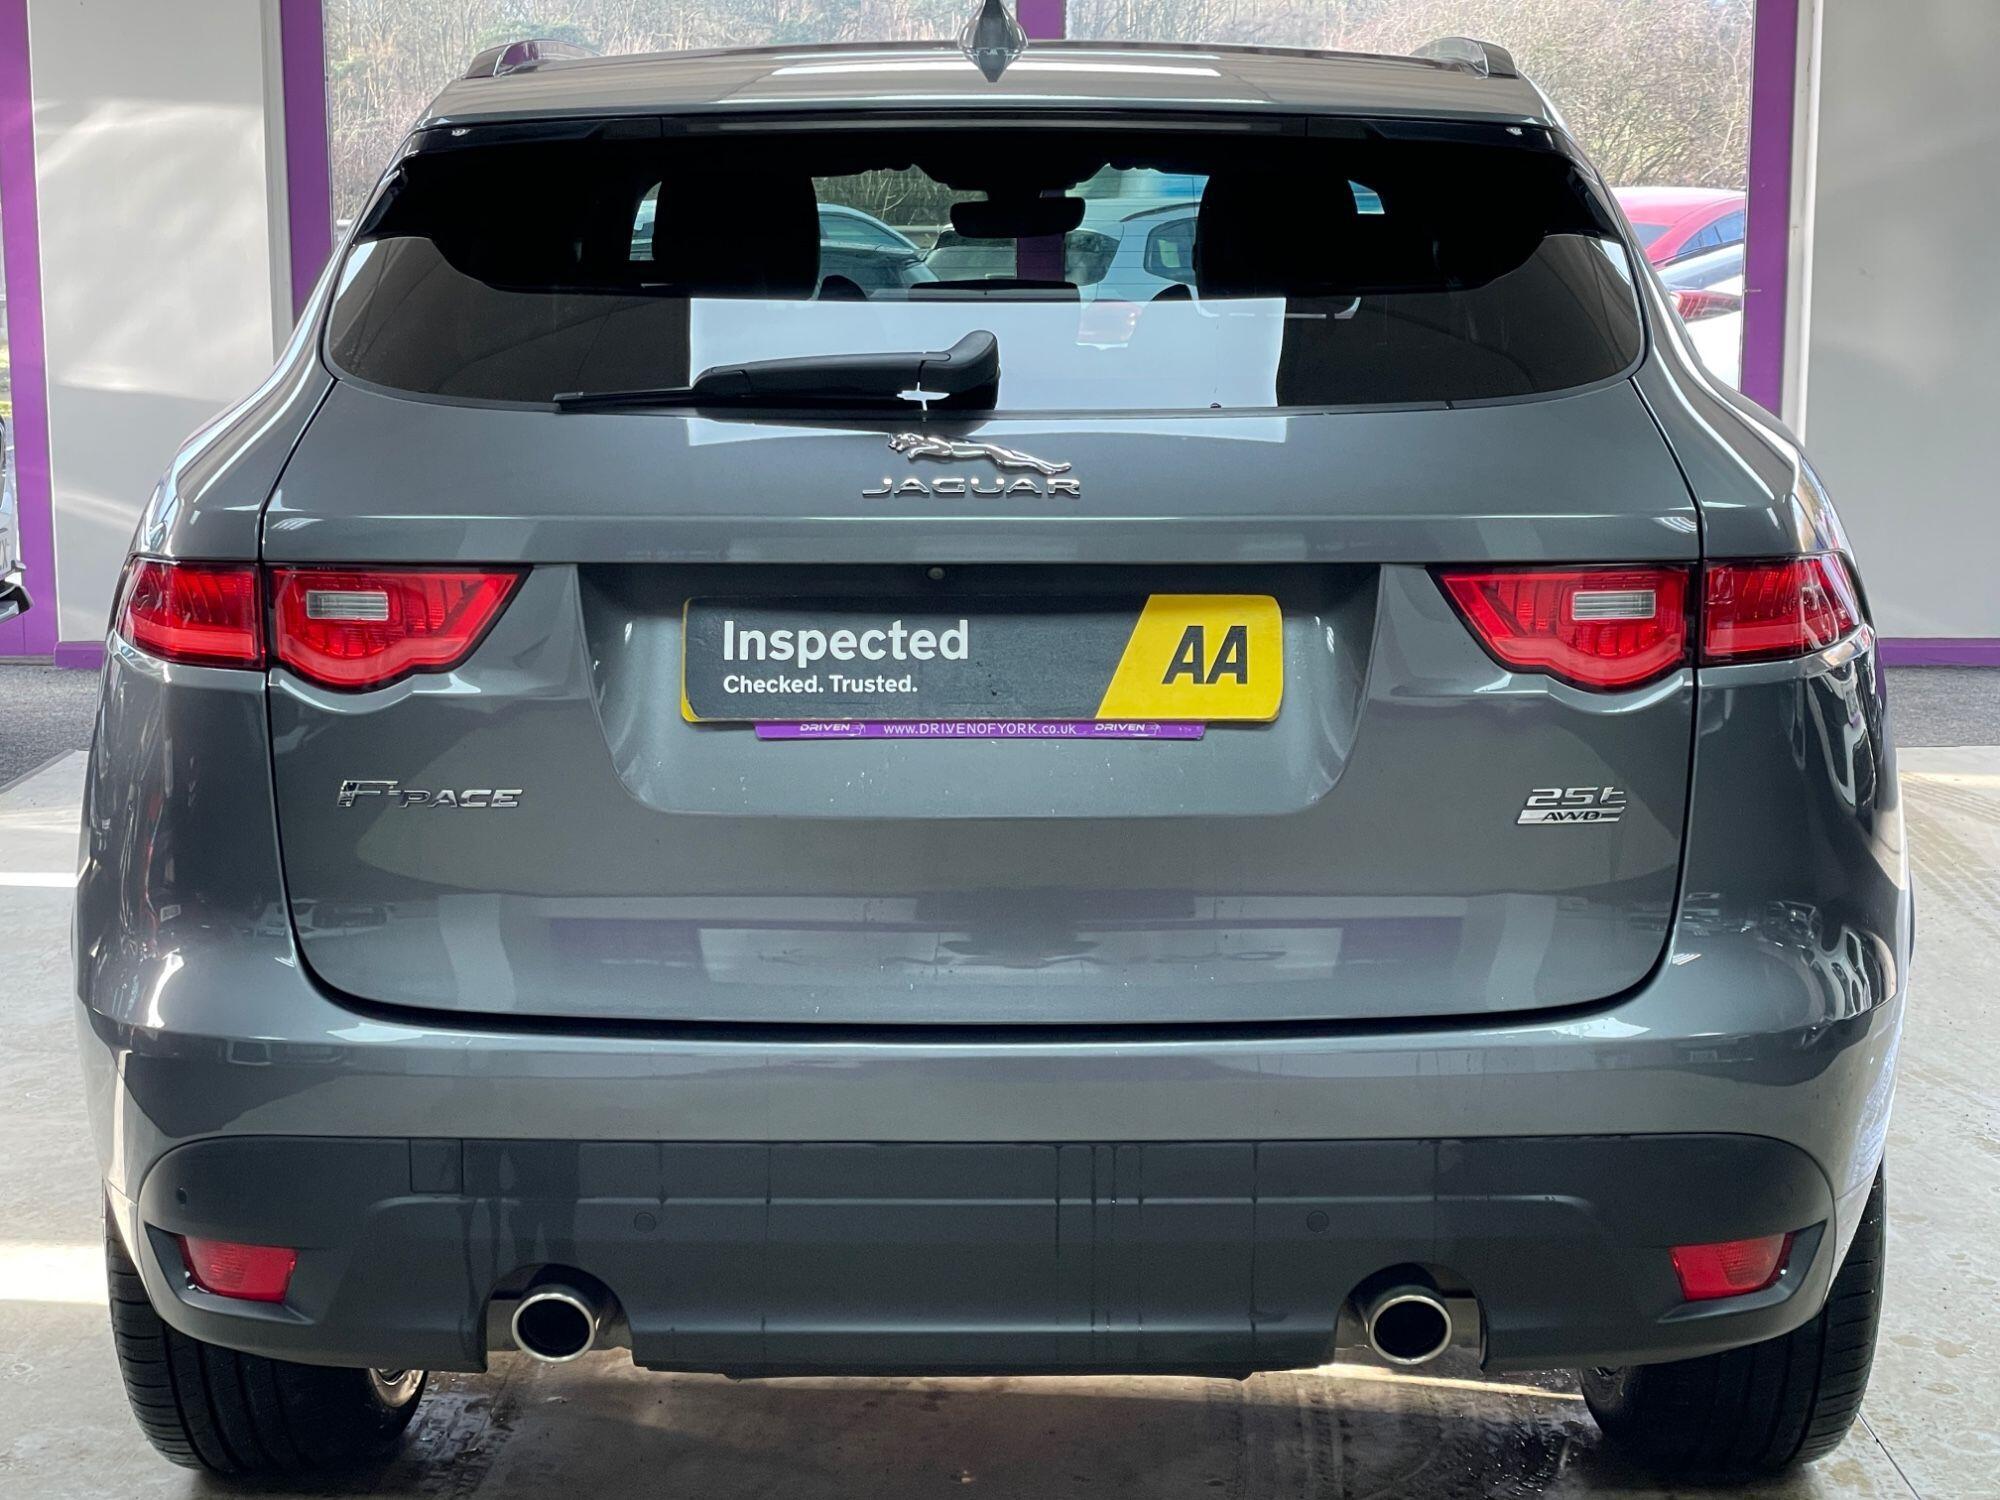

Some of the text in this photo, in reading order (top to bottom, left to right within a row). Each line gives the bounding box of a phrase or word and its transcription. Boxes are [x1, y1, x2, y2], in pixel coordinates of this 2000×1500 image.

[862, 478, 1081, 497] JAGUAR
[723, 619, 969, 669] Inspected
[1161, 625, 1248, 685] AA
[723, 674, 918, 694] Checked. Trusted.
[799, 723, 851, 732] DRIVEN
[883, 722, 1077, 735] www.DRIVENOFYORK.co.uk
[1094, 723, 1146, 731] DRIVEN
[1541, 810, 1602, 821] AWD
